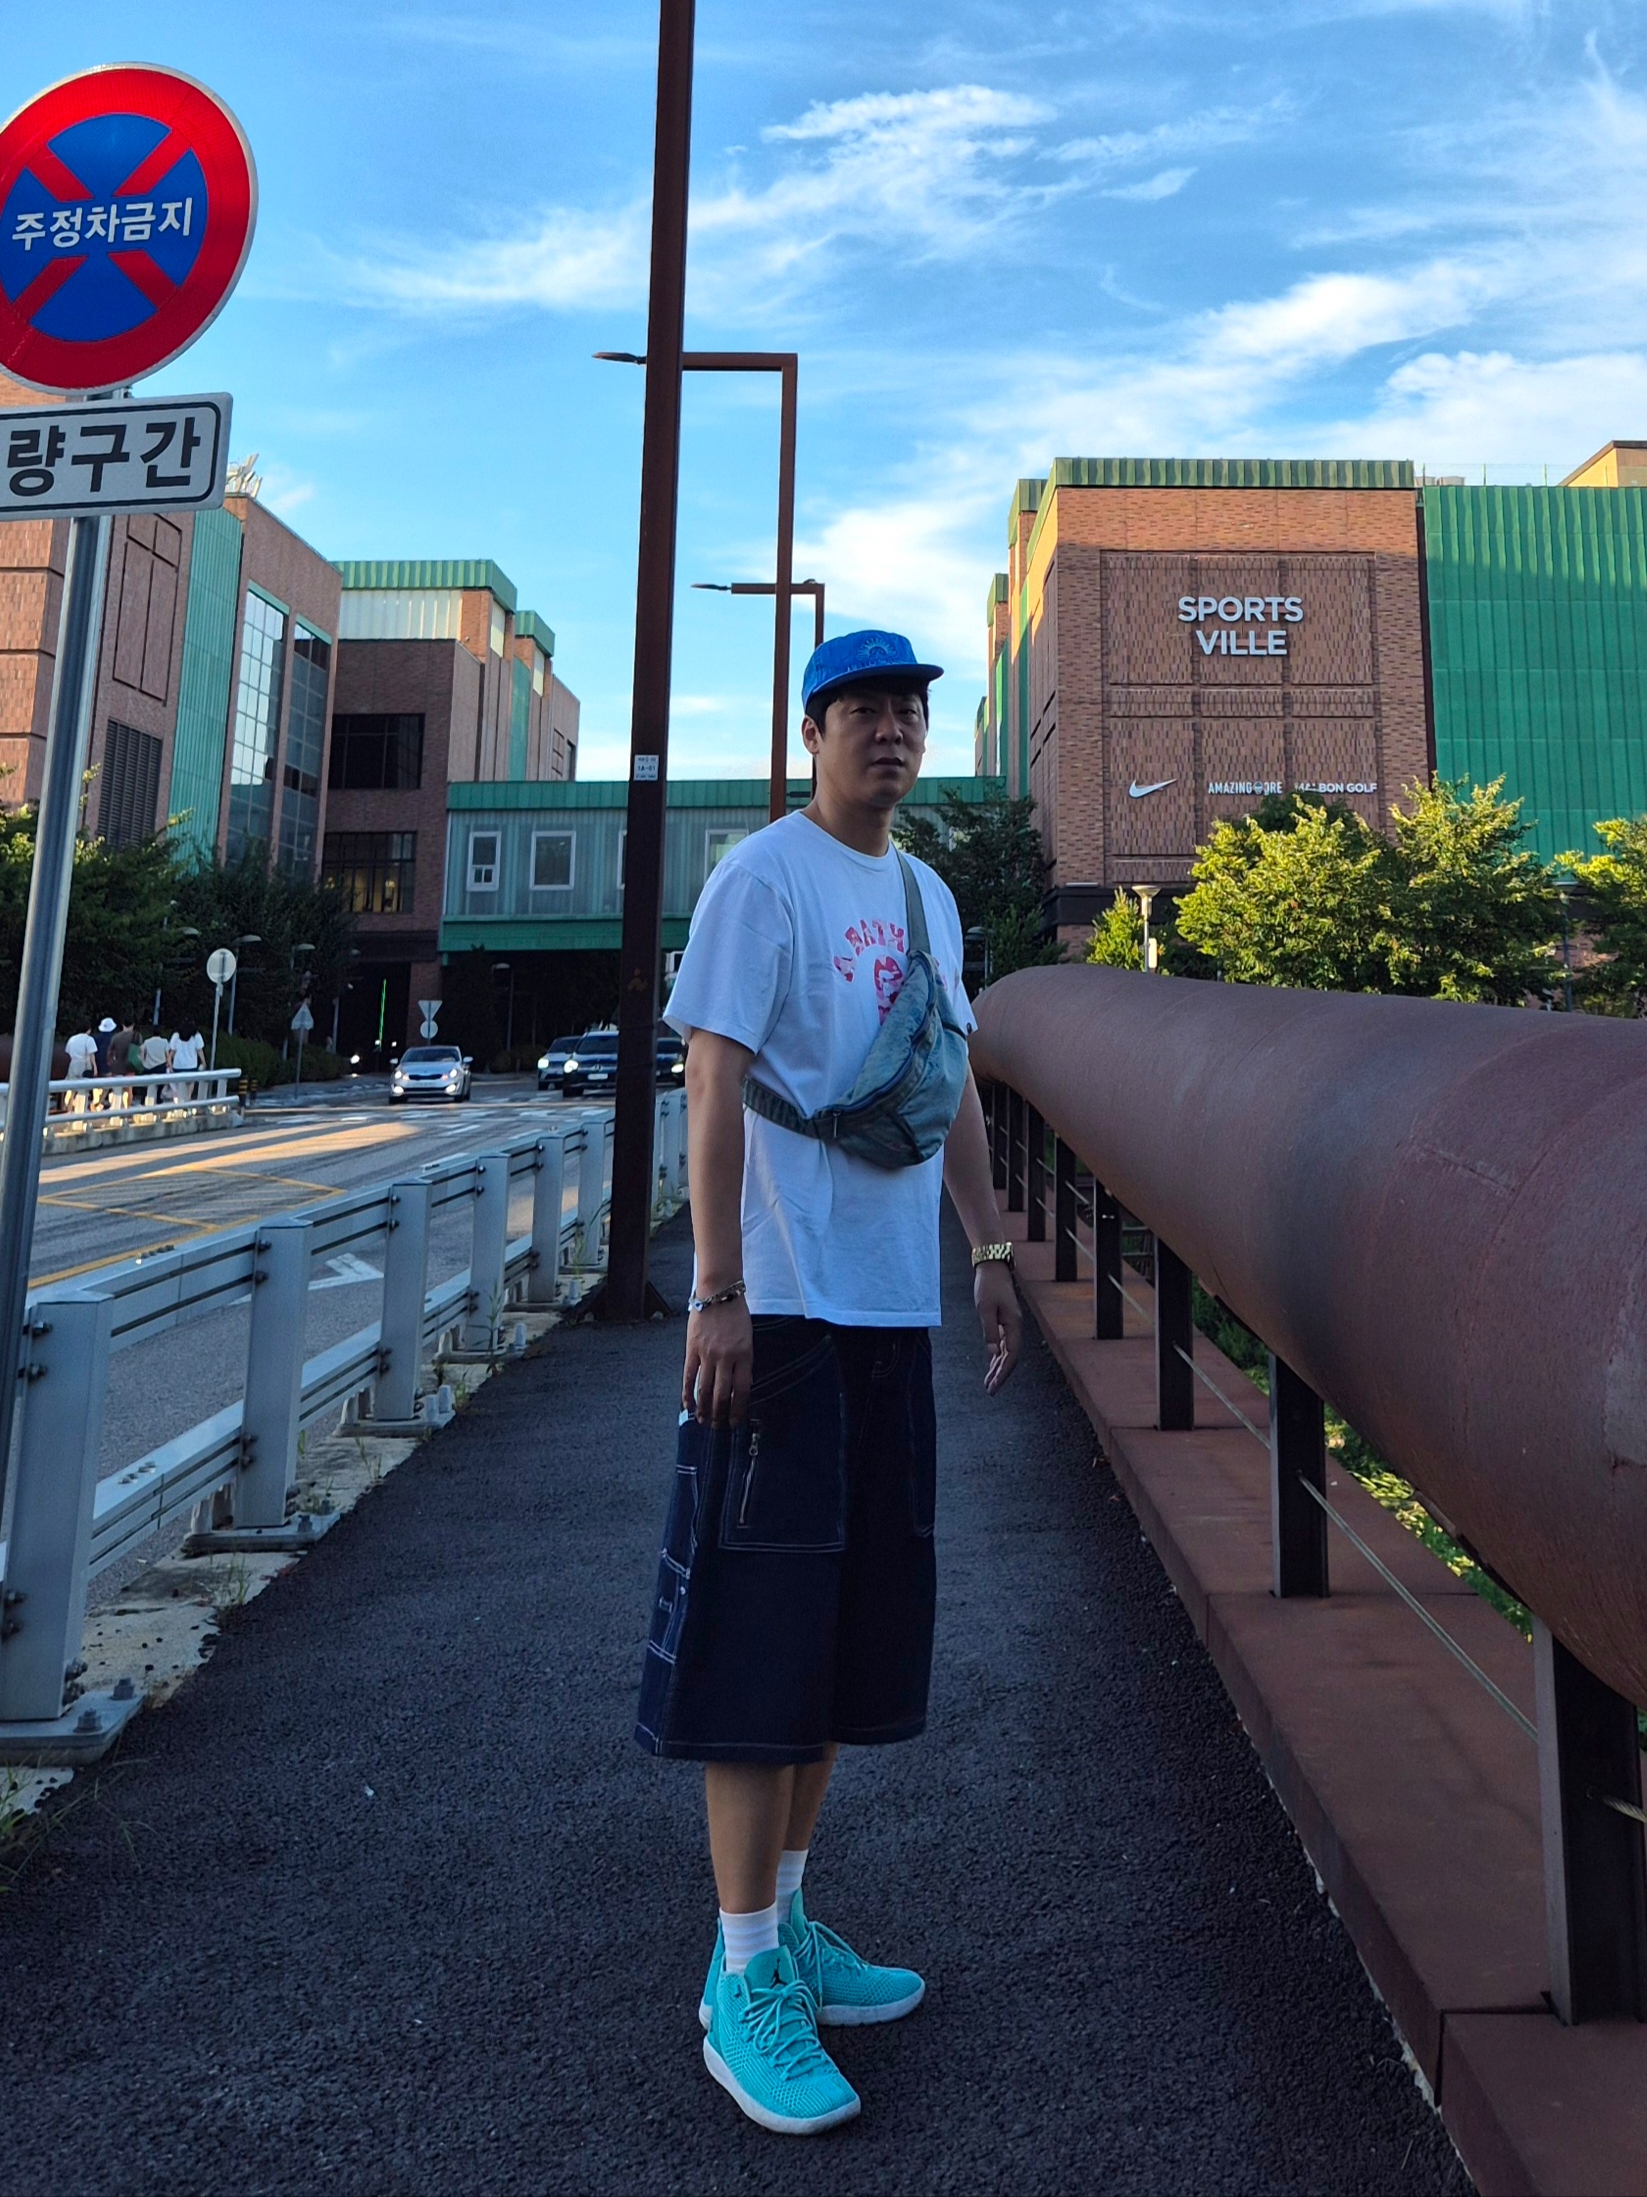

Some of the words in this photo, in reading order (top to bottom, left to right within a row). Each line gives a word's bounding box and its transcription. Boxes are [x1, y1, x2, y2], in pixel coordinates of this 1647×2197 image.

[12, 197, 194, 251] 주정차금지
[7, 416, 201, 496] 량구간
[1178, 596, 1304, 622] SPORTS
[1196, 630, 1287, 655] VILLE
[1346, 782, 1378, 794] GOLF
